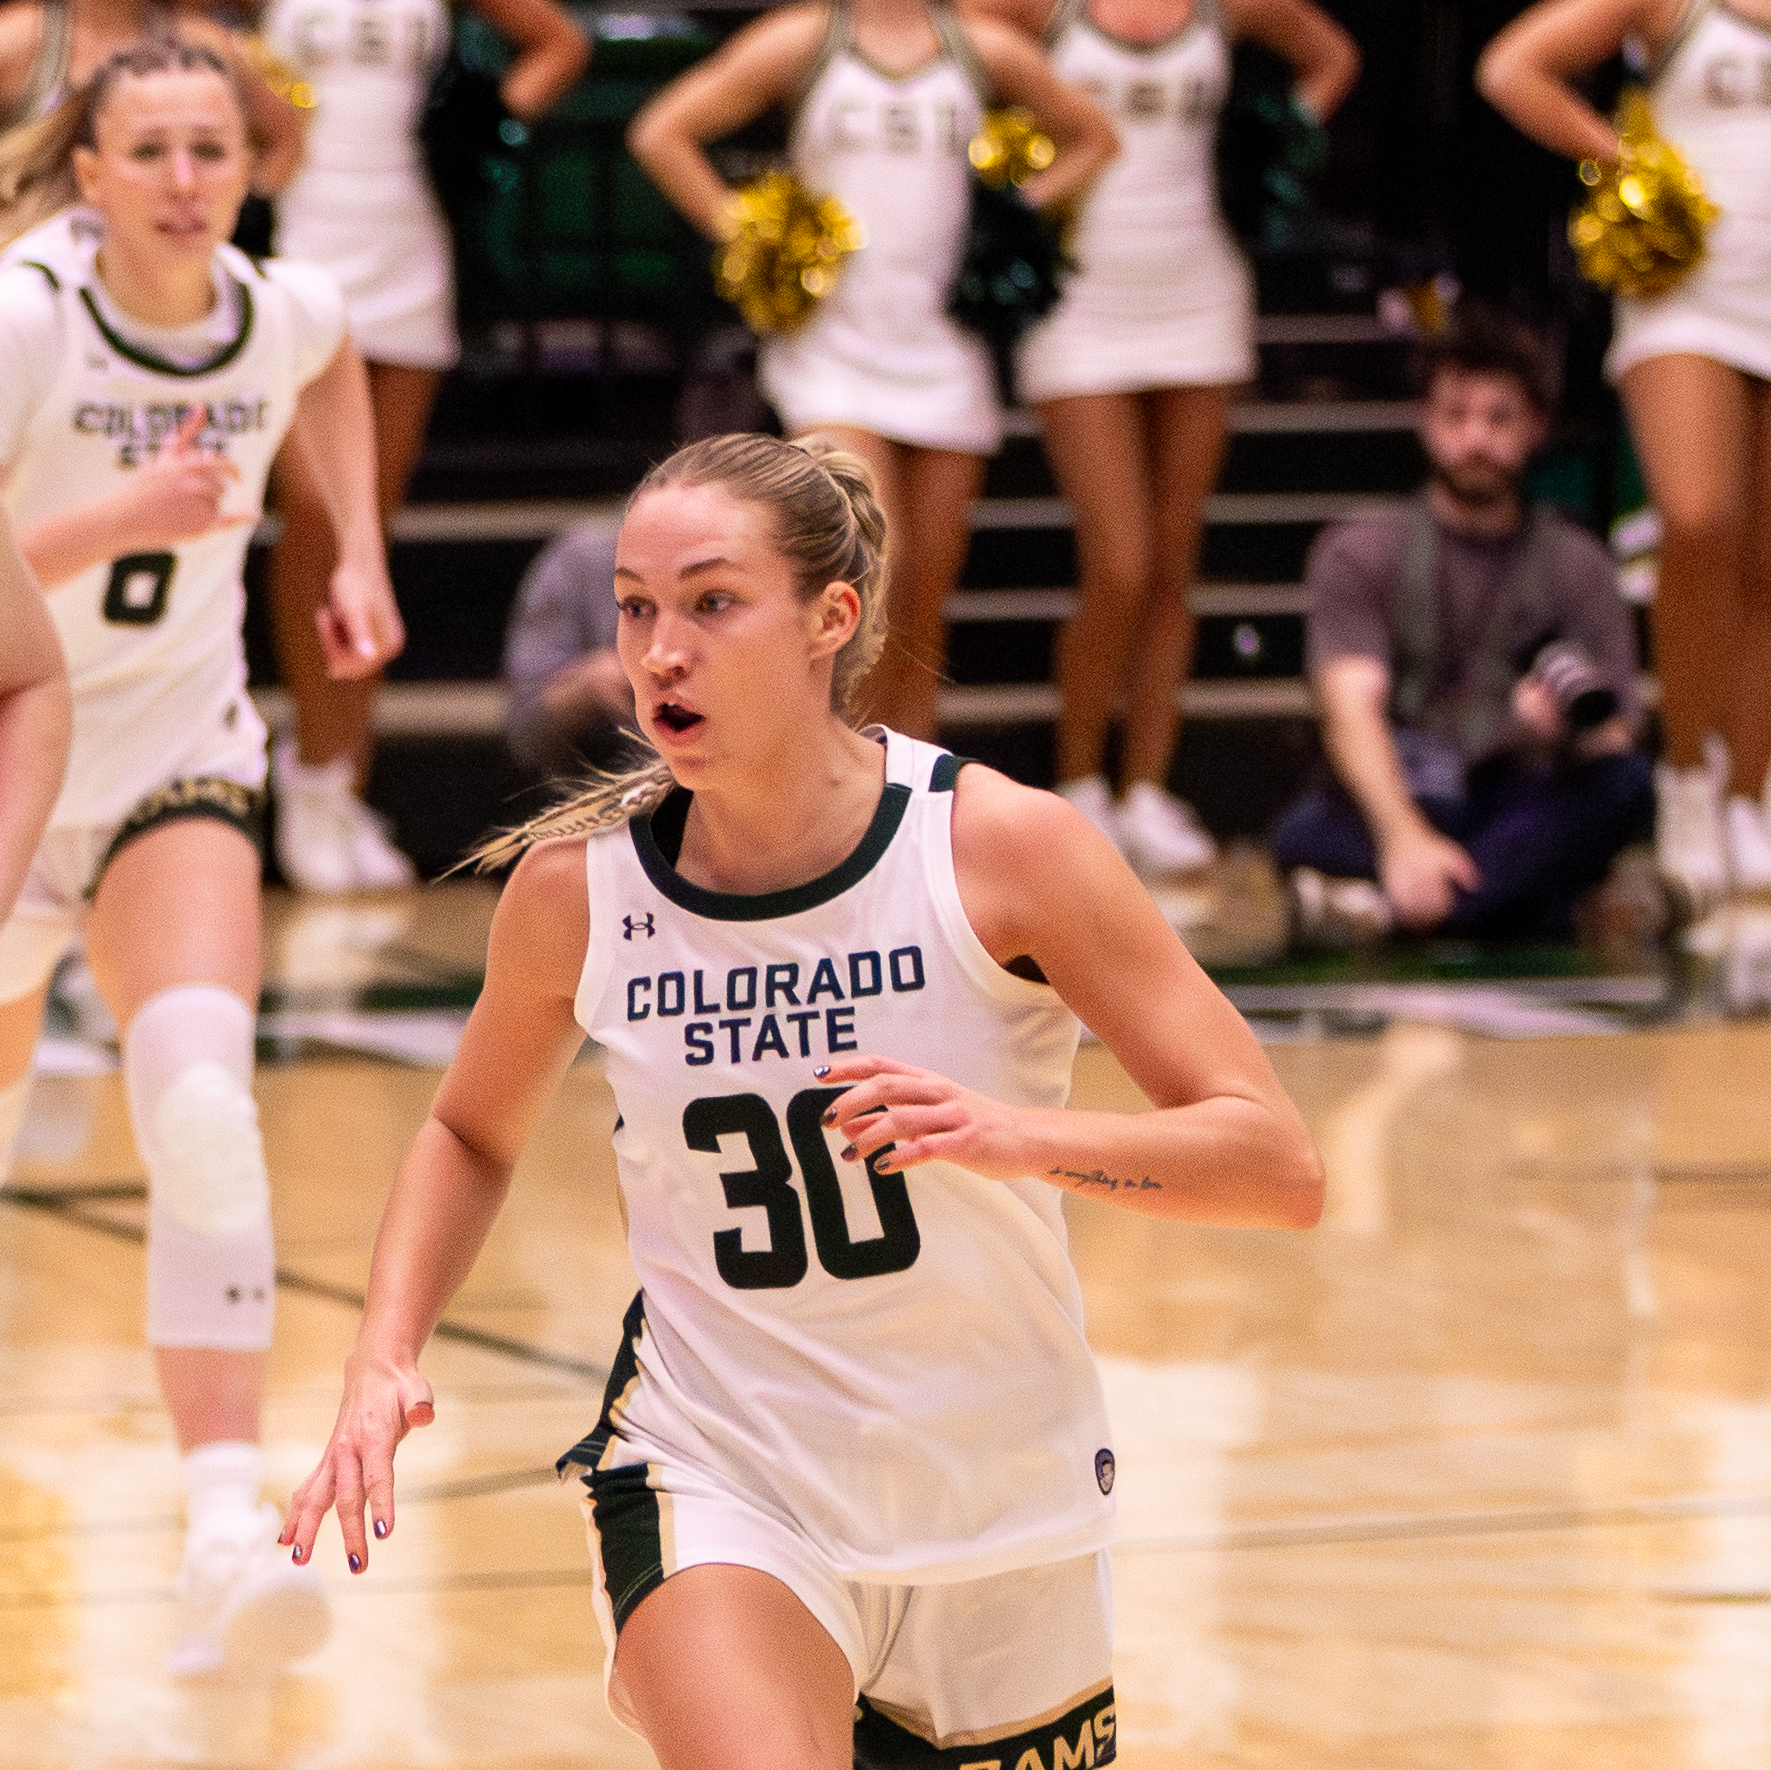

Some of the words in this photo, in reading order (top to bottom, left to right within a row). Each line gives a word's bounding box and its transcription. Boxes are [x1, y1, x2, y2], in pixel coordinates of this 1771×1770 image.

[627, 945, 926, 1022] COLORADO
[684, 1006, 858, 1067] STATE
[682, 1084, 921, 1291] 30
